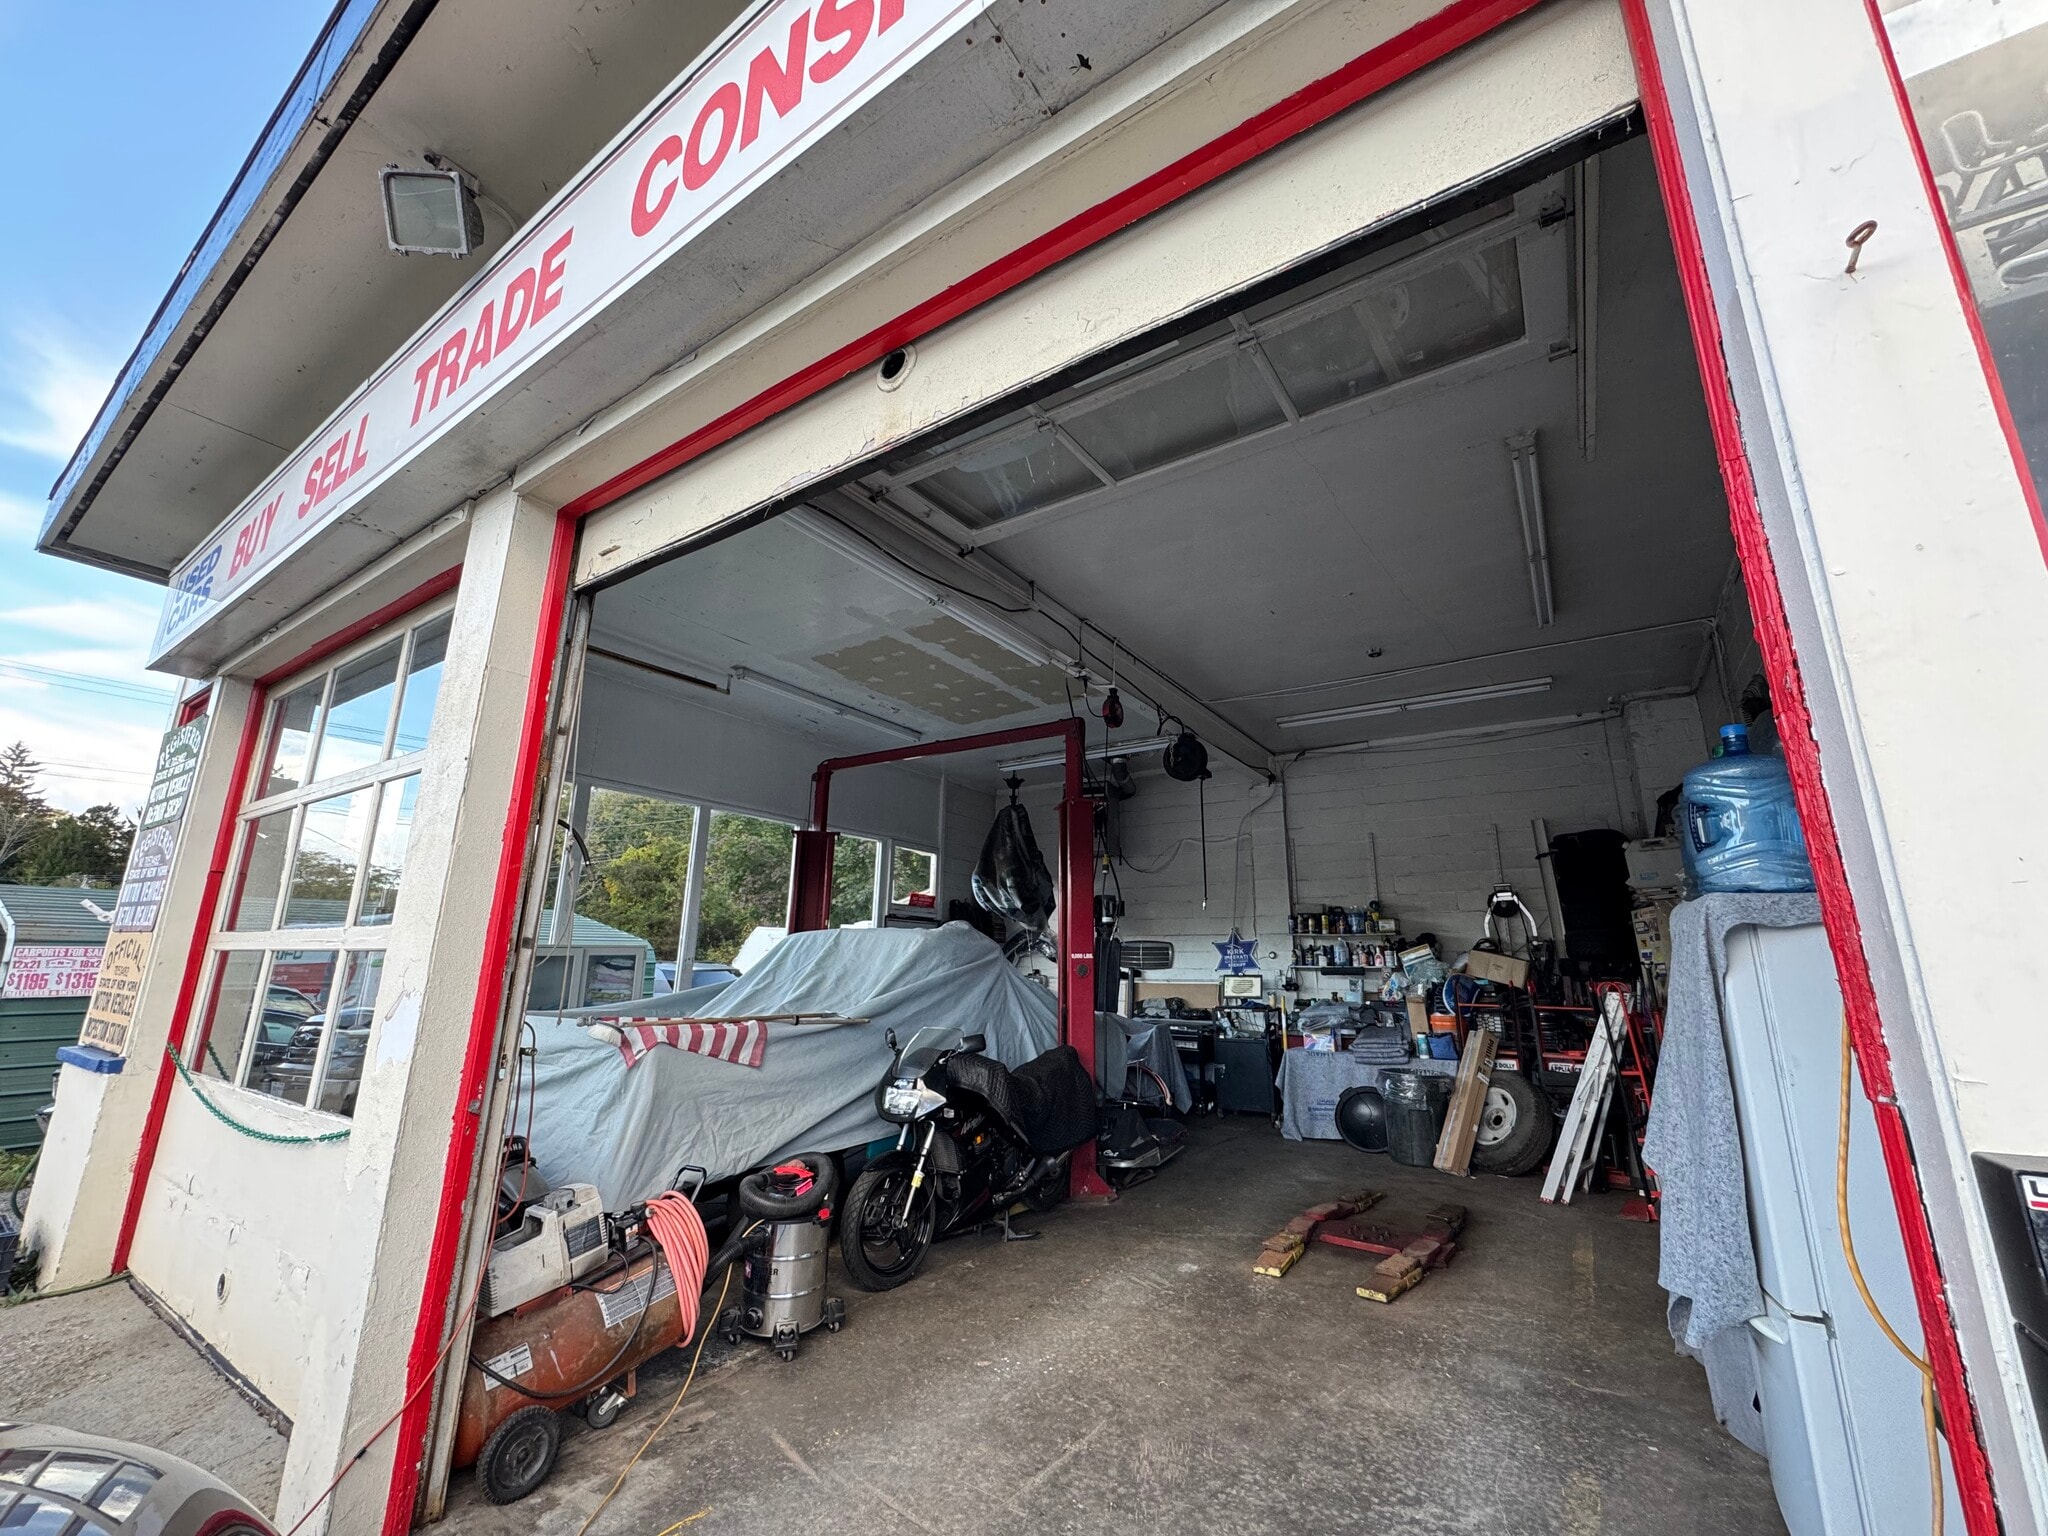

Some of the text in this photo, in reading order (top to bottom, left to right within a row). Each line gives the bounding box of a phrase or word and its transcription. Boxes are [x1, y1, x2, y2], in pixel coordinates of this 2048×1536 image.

[227, 490, 285, 581] BUY
[297, 412, 369, 520] SELL
[410, 225, 574, 428] TRADE
[175, 544, 223, 602] USED
[166, 575, 214, 635] CARS
[159, 725, 201, 770] REGISTERED
[155, 769, 168, 782] STATE
[174, 762, 184, 775] NEW
[184, 757, 197, 771] YORK
[167, 771, 194, 798] VEHICLE
[133, 826, 174, 868] REGISTERED
[128, 869, 141, 879] STATE
[146, 867, 157, 878] NEW
[157, 865, 169, 876] YORK
[140, 880, 166, 902] VEHICLE
[12, 960, 101, 969] 12x21 18x2
[16, 948, 104, 957] CARPORTS FOR SAL
[106, 938, 145, 972] OFFICIAL
[7, 972, 50, 990] $1195
[99, 977, 111, 991] STATE
[116, 979, 126, 990] NEW
[127, 981, 138, 992] YORK
[110, 992, 136, 1017] VEHICLE
